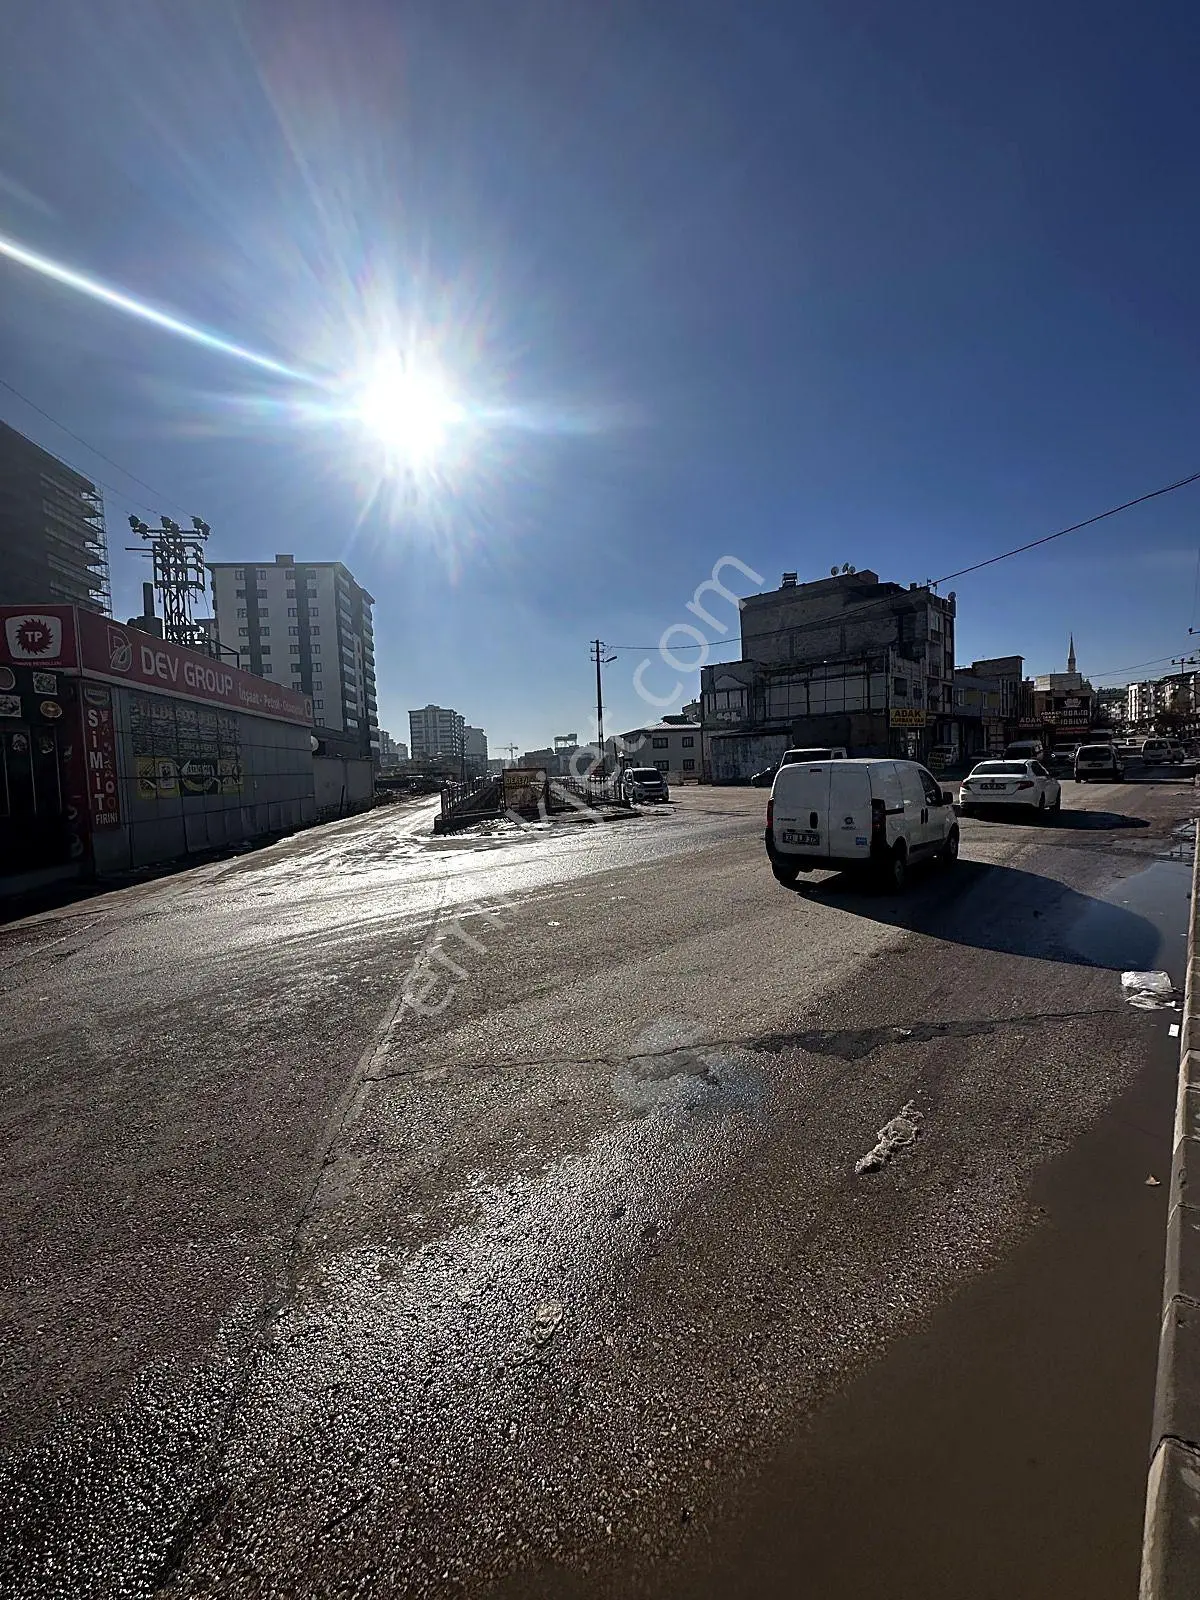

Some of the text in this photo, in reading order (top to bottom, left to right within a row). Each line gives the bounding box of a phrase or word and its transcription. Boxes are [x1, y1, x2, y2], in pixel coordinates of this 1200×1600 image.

[24, 631, 43, 643] TP
[140, 645, 179, 683] DEV
[183, 660, 233, 697] GROUP
[894, 709, 921, 718] ADAK
[95, 812, 119, 825] FIRINI
